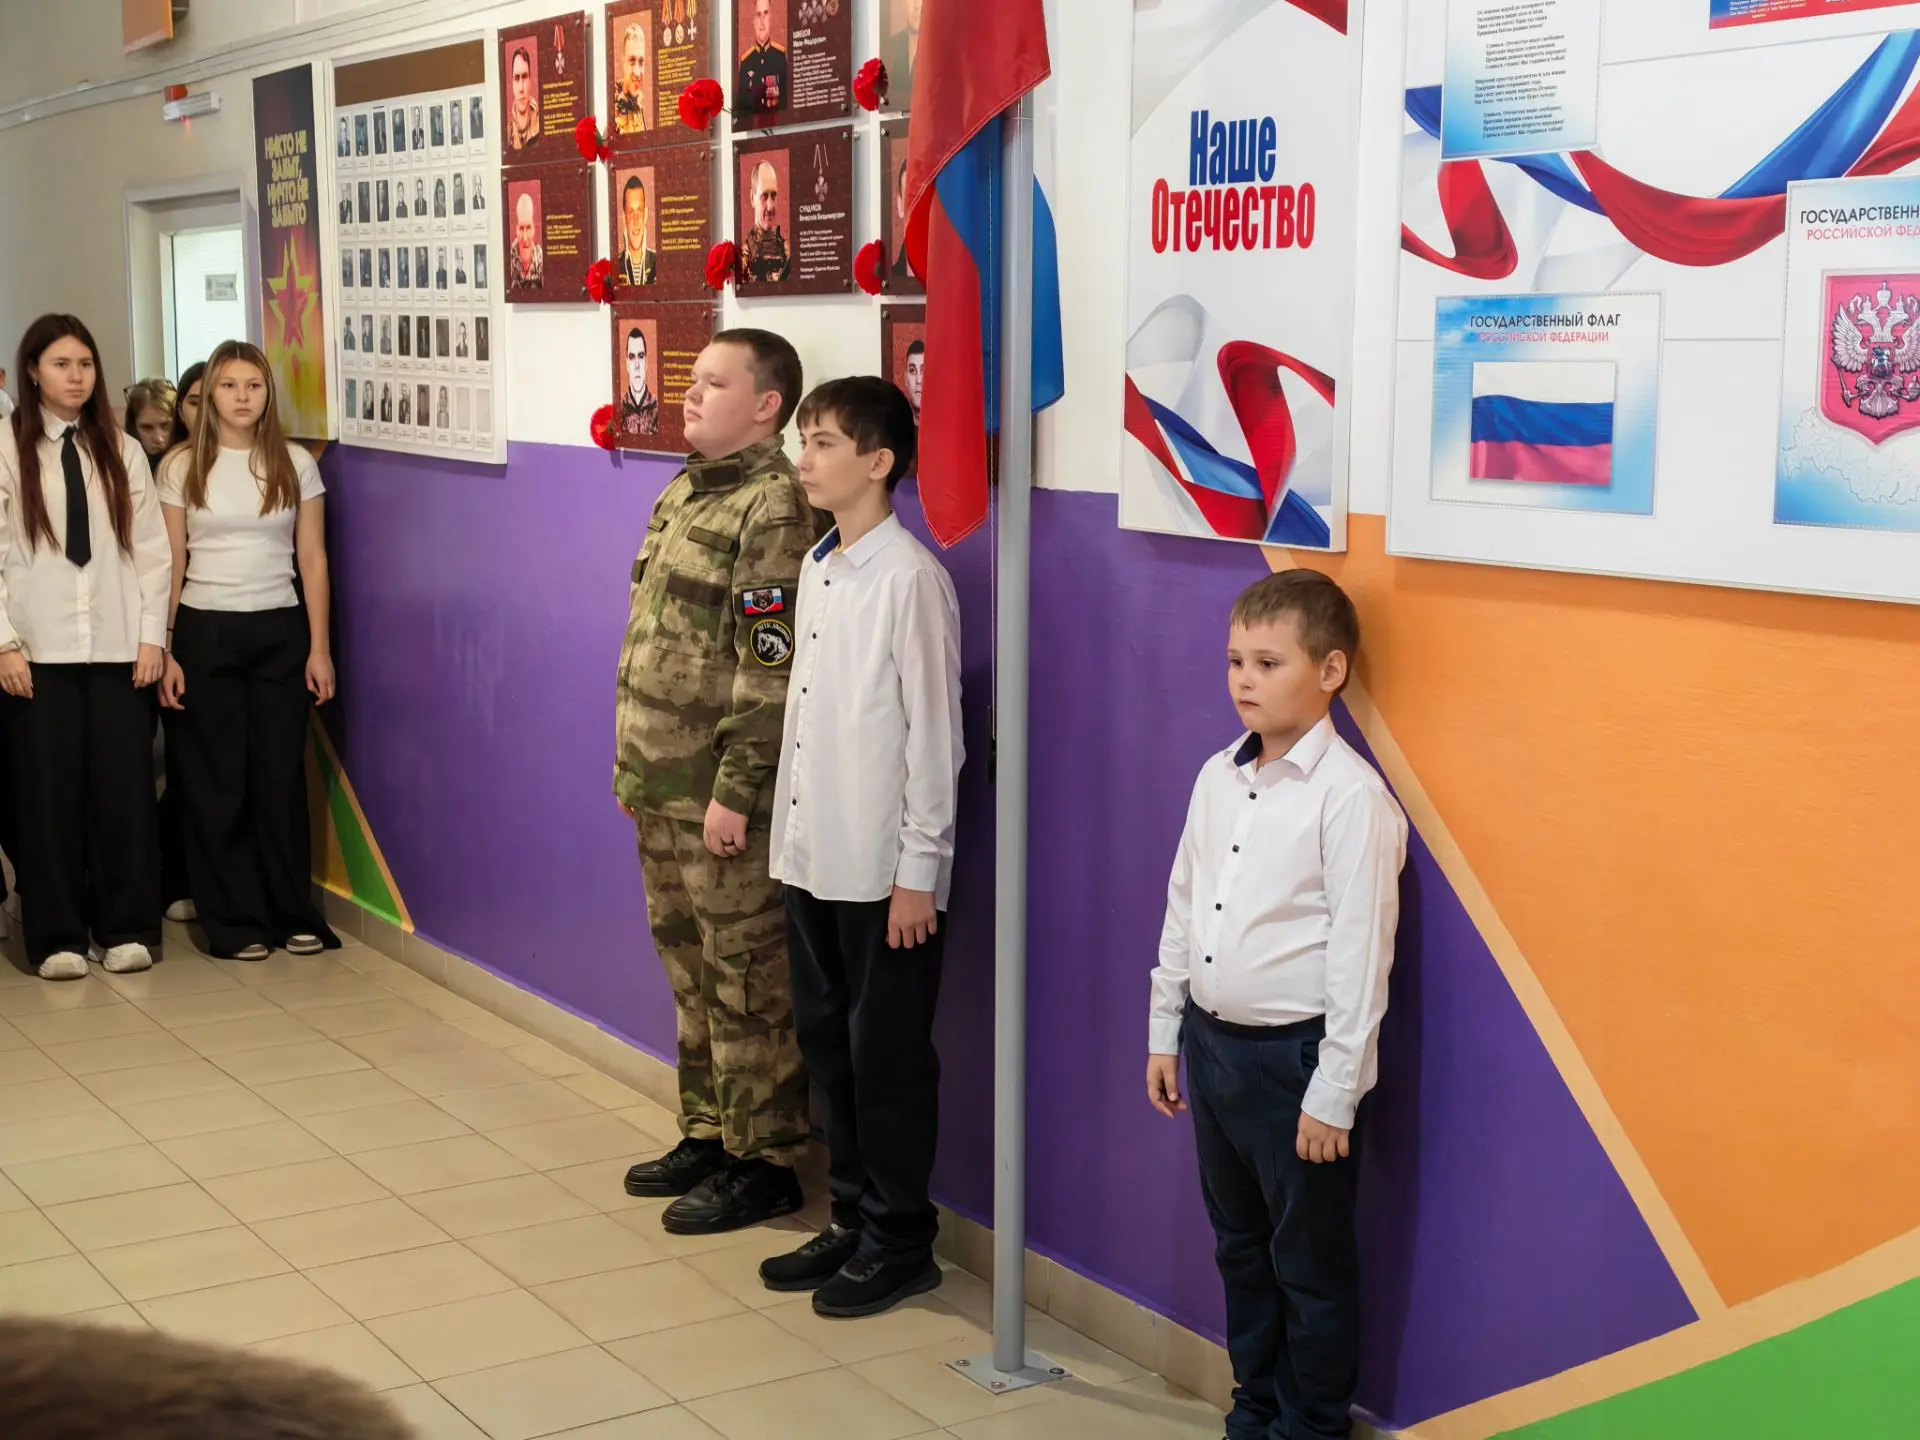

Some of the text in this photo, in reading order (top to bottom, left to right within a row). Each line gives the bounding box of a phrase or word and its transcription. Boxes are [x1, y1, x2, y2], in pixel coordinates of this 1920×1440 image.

[1189, 110, 1277, 186] Наше
[1151, 177, 1316, 254] Отечество
[1807, 223, 1892, 240] РОССИЙСКОЙ
[1470, 312, 1621, 329] ГОСУДАРСТВЕННЫЙ ФЛАГ
[1479, 331, 1609, 343] РОССИЙСКОЙ ФЕДЕРАЦИИ
